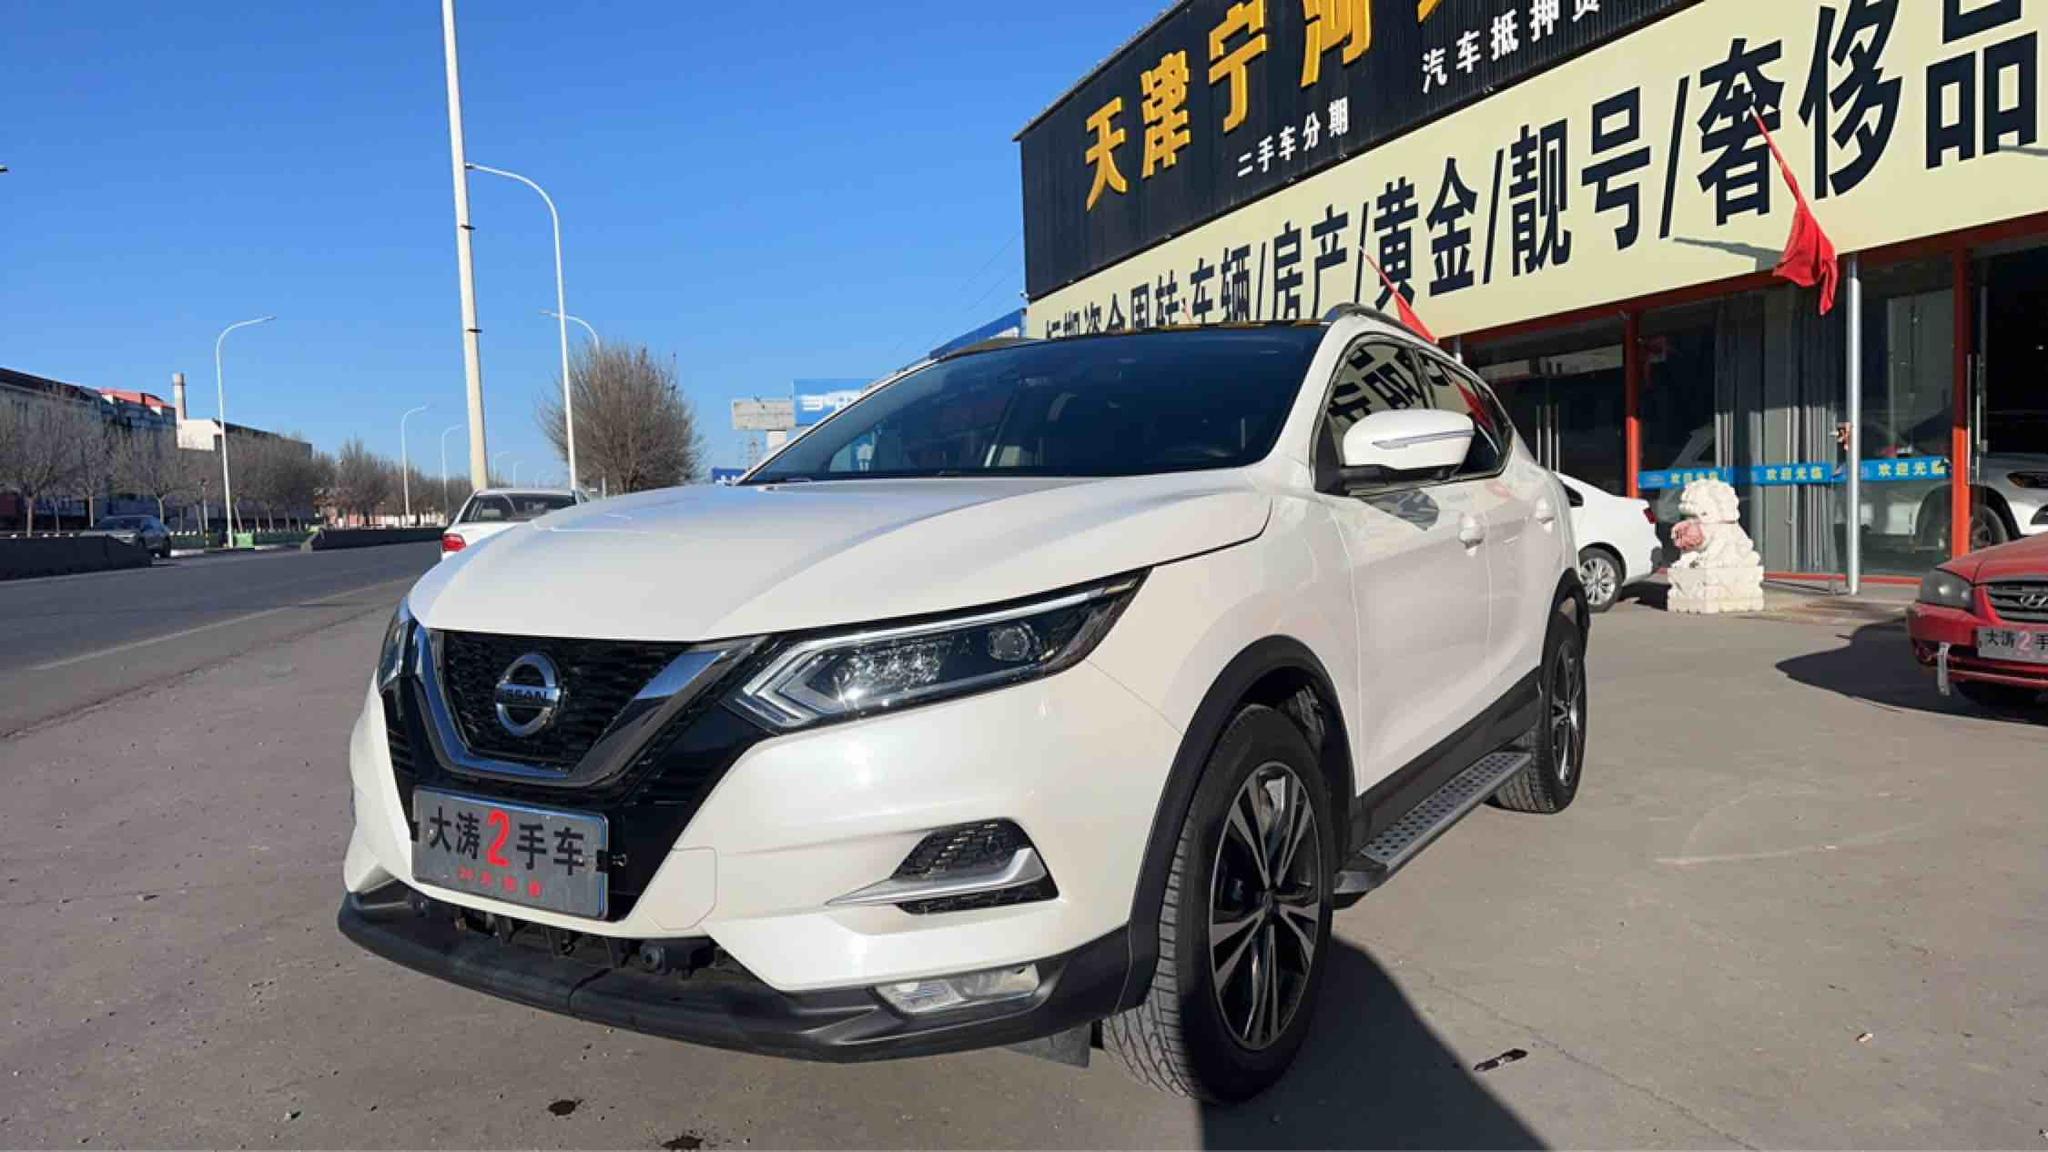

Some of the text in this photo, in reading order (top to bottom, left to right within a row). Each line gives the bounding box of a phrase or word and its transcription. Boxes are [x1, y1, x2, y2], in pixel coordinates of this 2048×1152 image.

[1086, 0, 1441, 211] 天津宁河
[1238, 96, 1349, 177] 二手车分期
[429, 806, 585, 876] 大涛2手车
